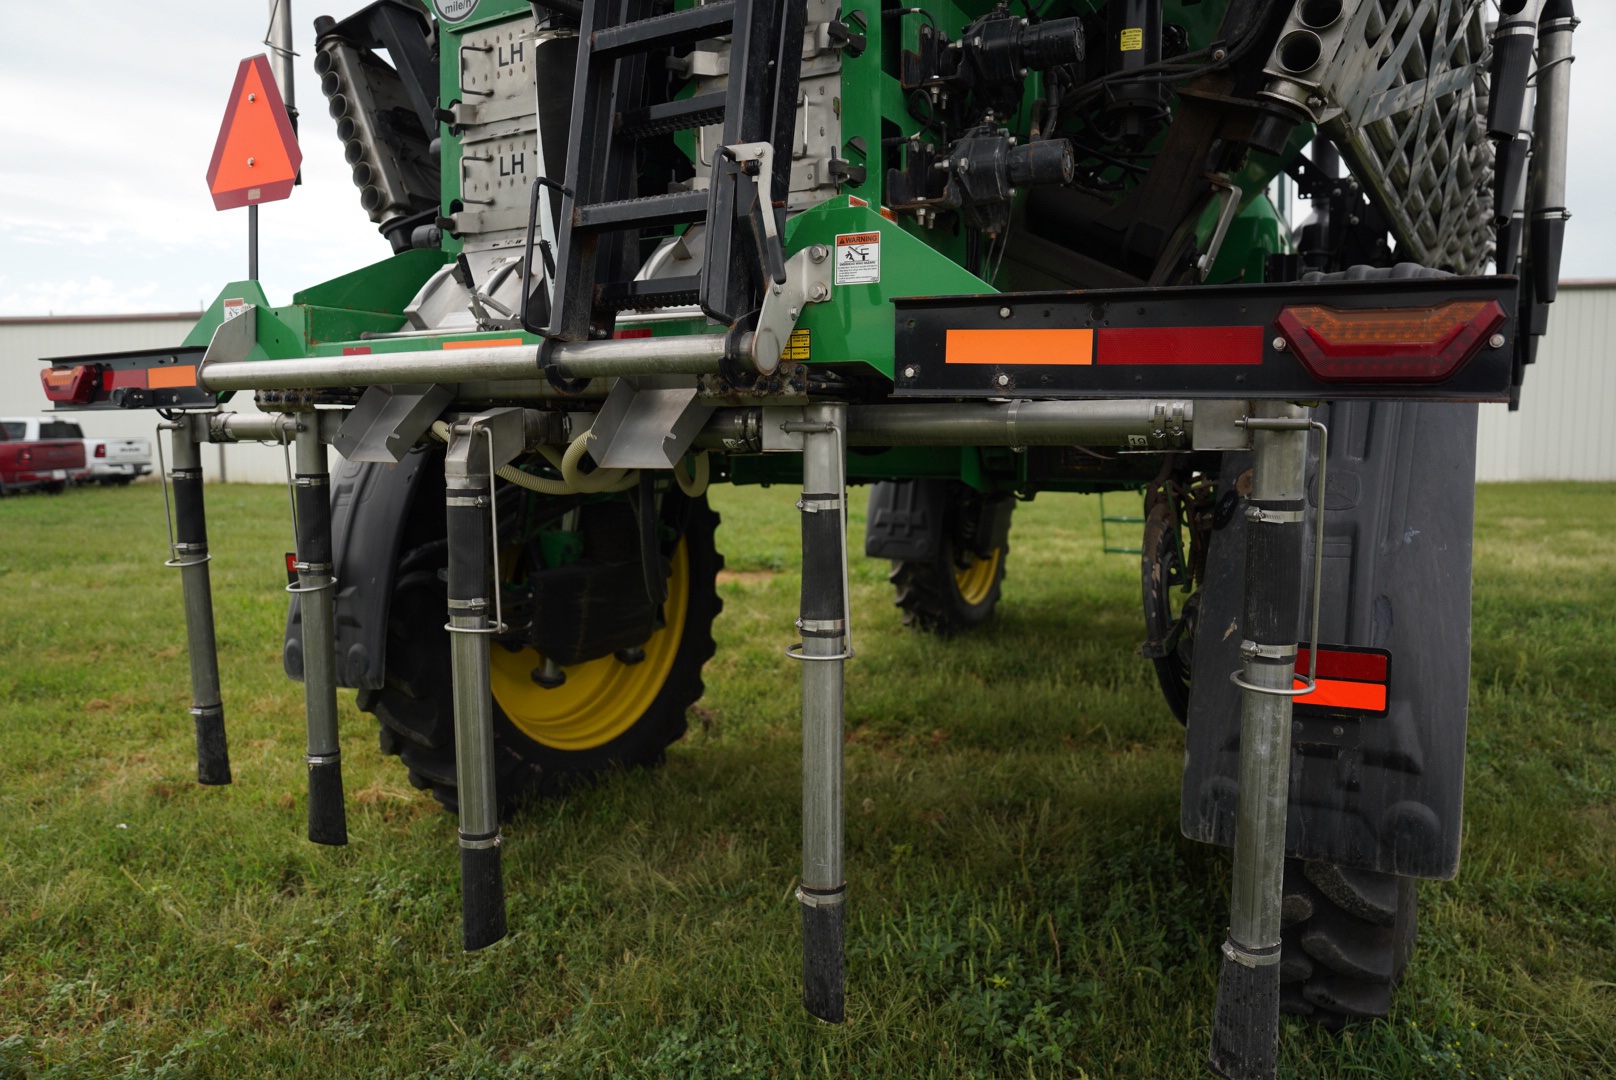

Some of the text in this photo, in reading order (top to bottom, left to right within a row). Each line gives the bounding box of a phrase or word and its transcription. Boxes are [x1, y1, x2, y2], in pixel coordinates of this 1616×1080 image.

[445, 0, 472, 14] mile/h
[498, 41, 524, 67] LH
[500, 152, 524, 177] LH
[845, 235, 877, 243] WARNING
[1130, 437, 1146, 445] 19
